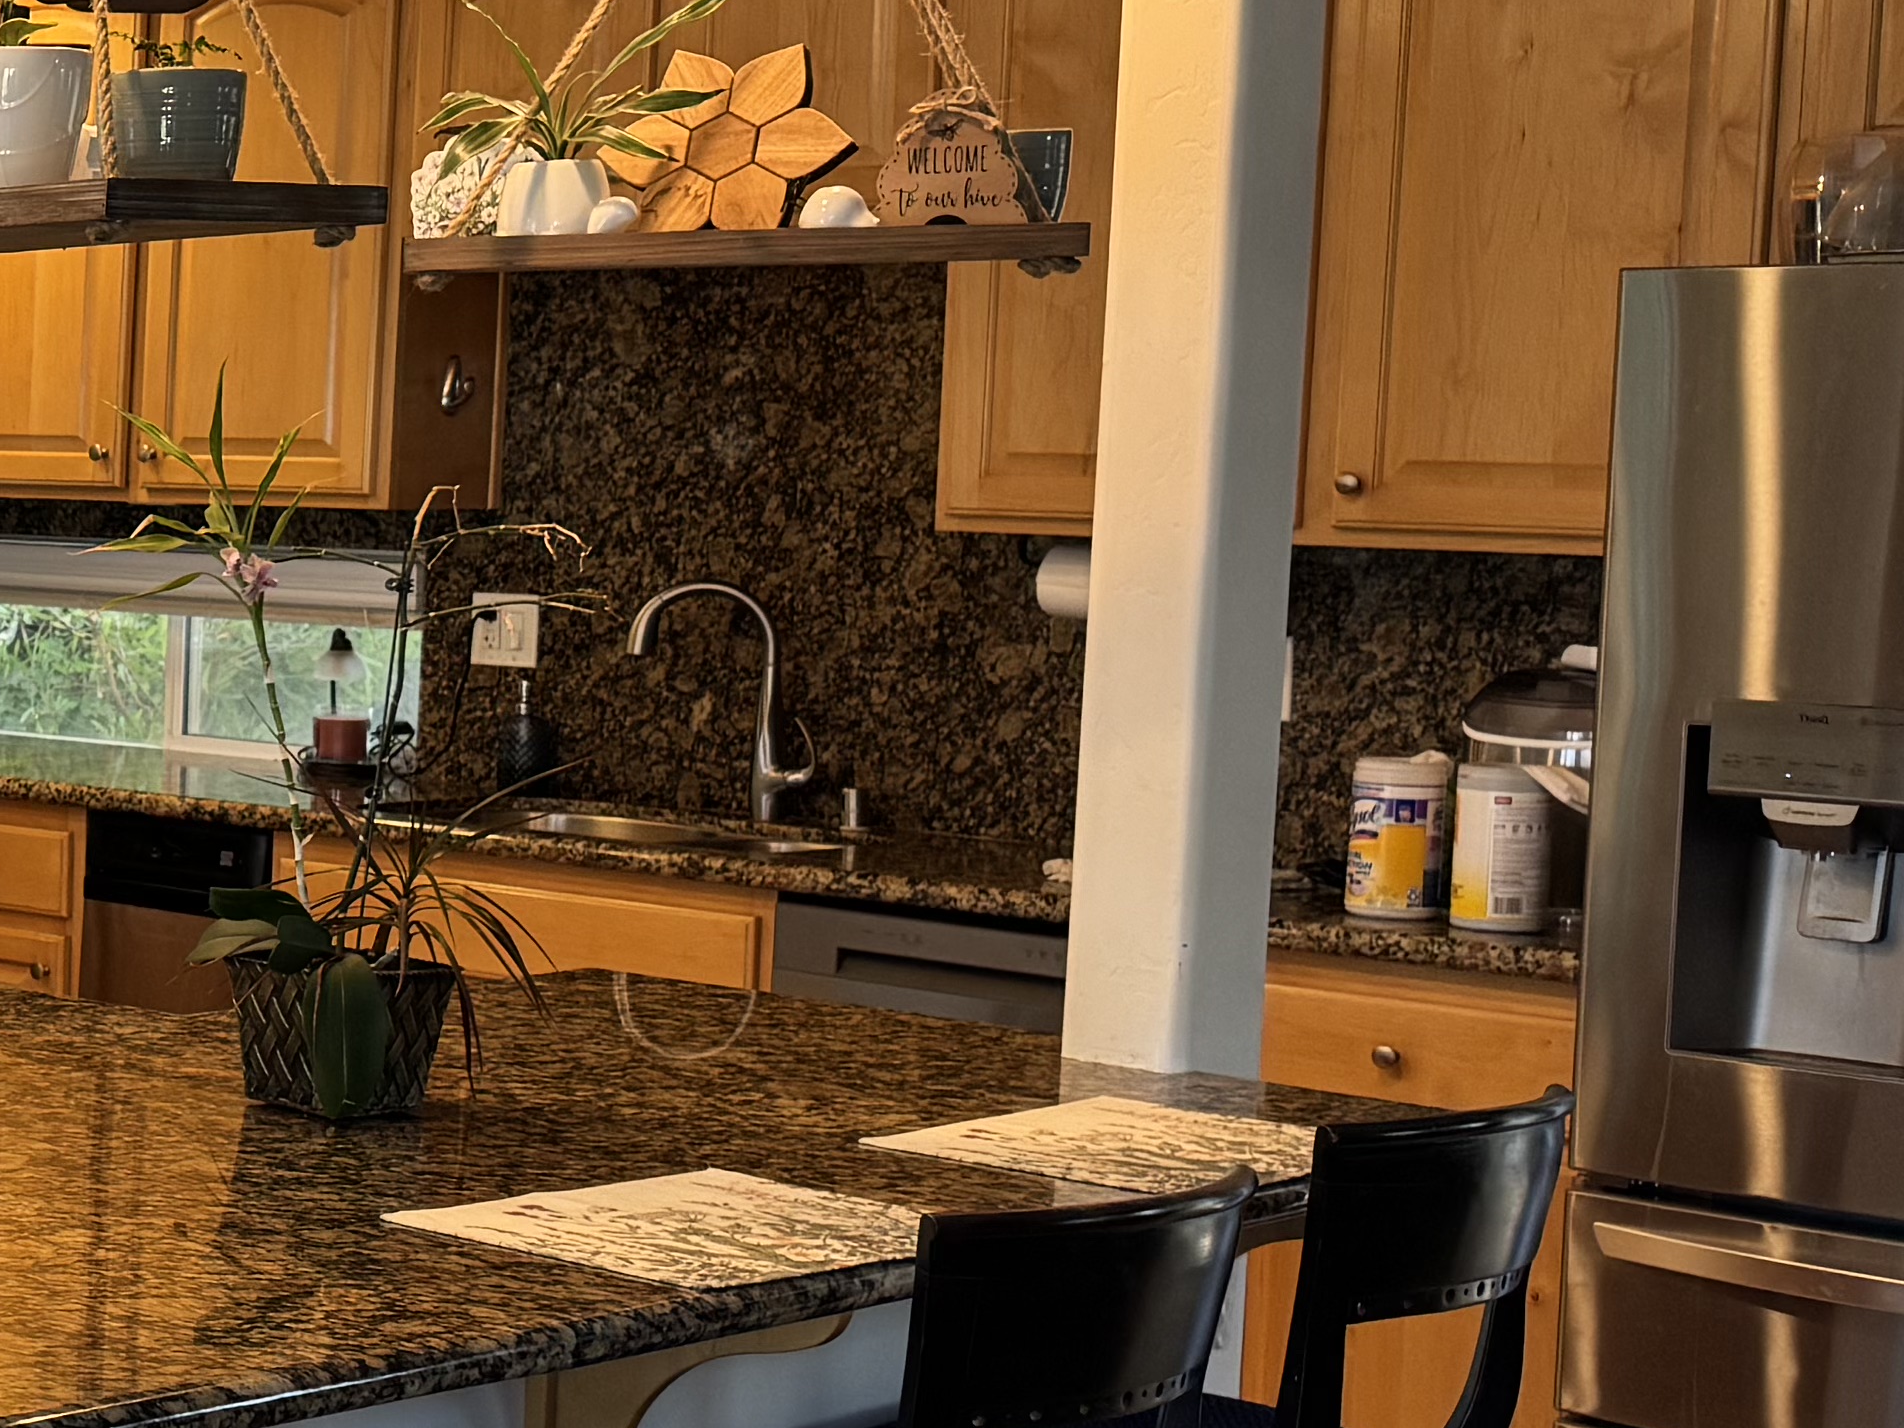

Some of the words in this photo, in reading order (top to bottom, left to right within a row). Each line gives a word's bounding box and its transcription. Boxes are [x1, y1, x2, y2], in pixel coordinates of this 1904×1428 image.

[907, 145, 988, 174] WELCOME
[891, 183, 920, 216] to
[925, 192, 958, 207] our
[963, 177, 1003, 208] hive
